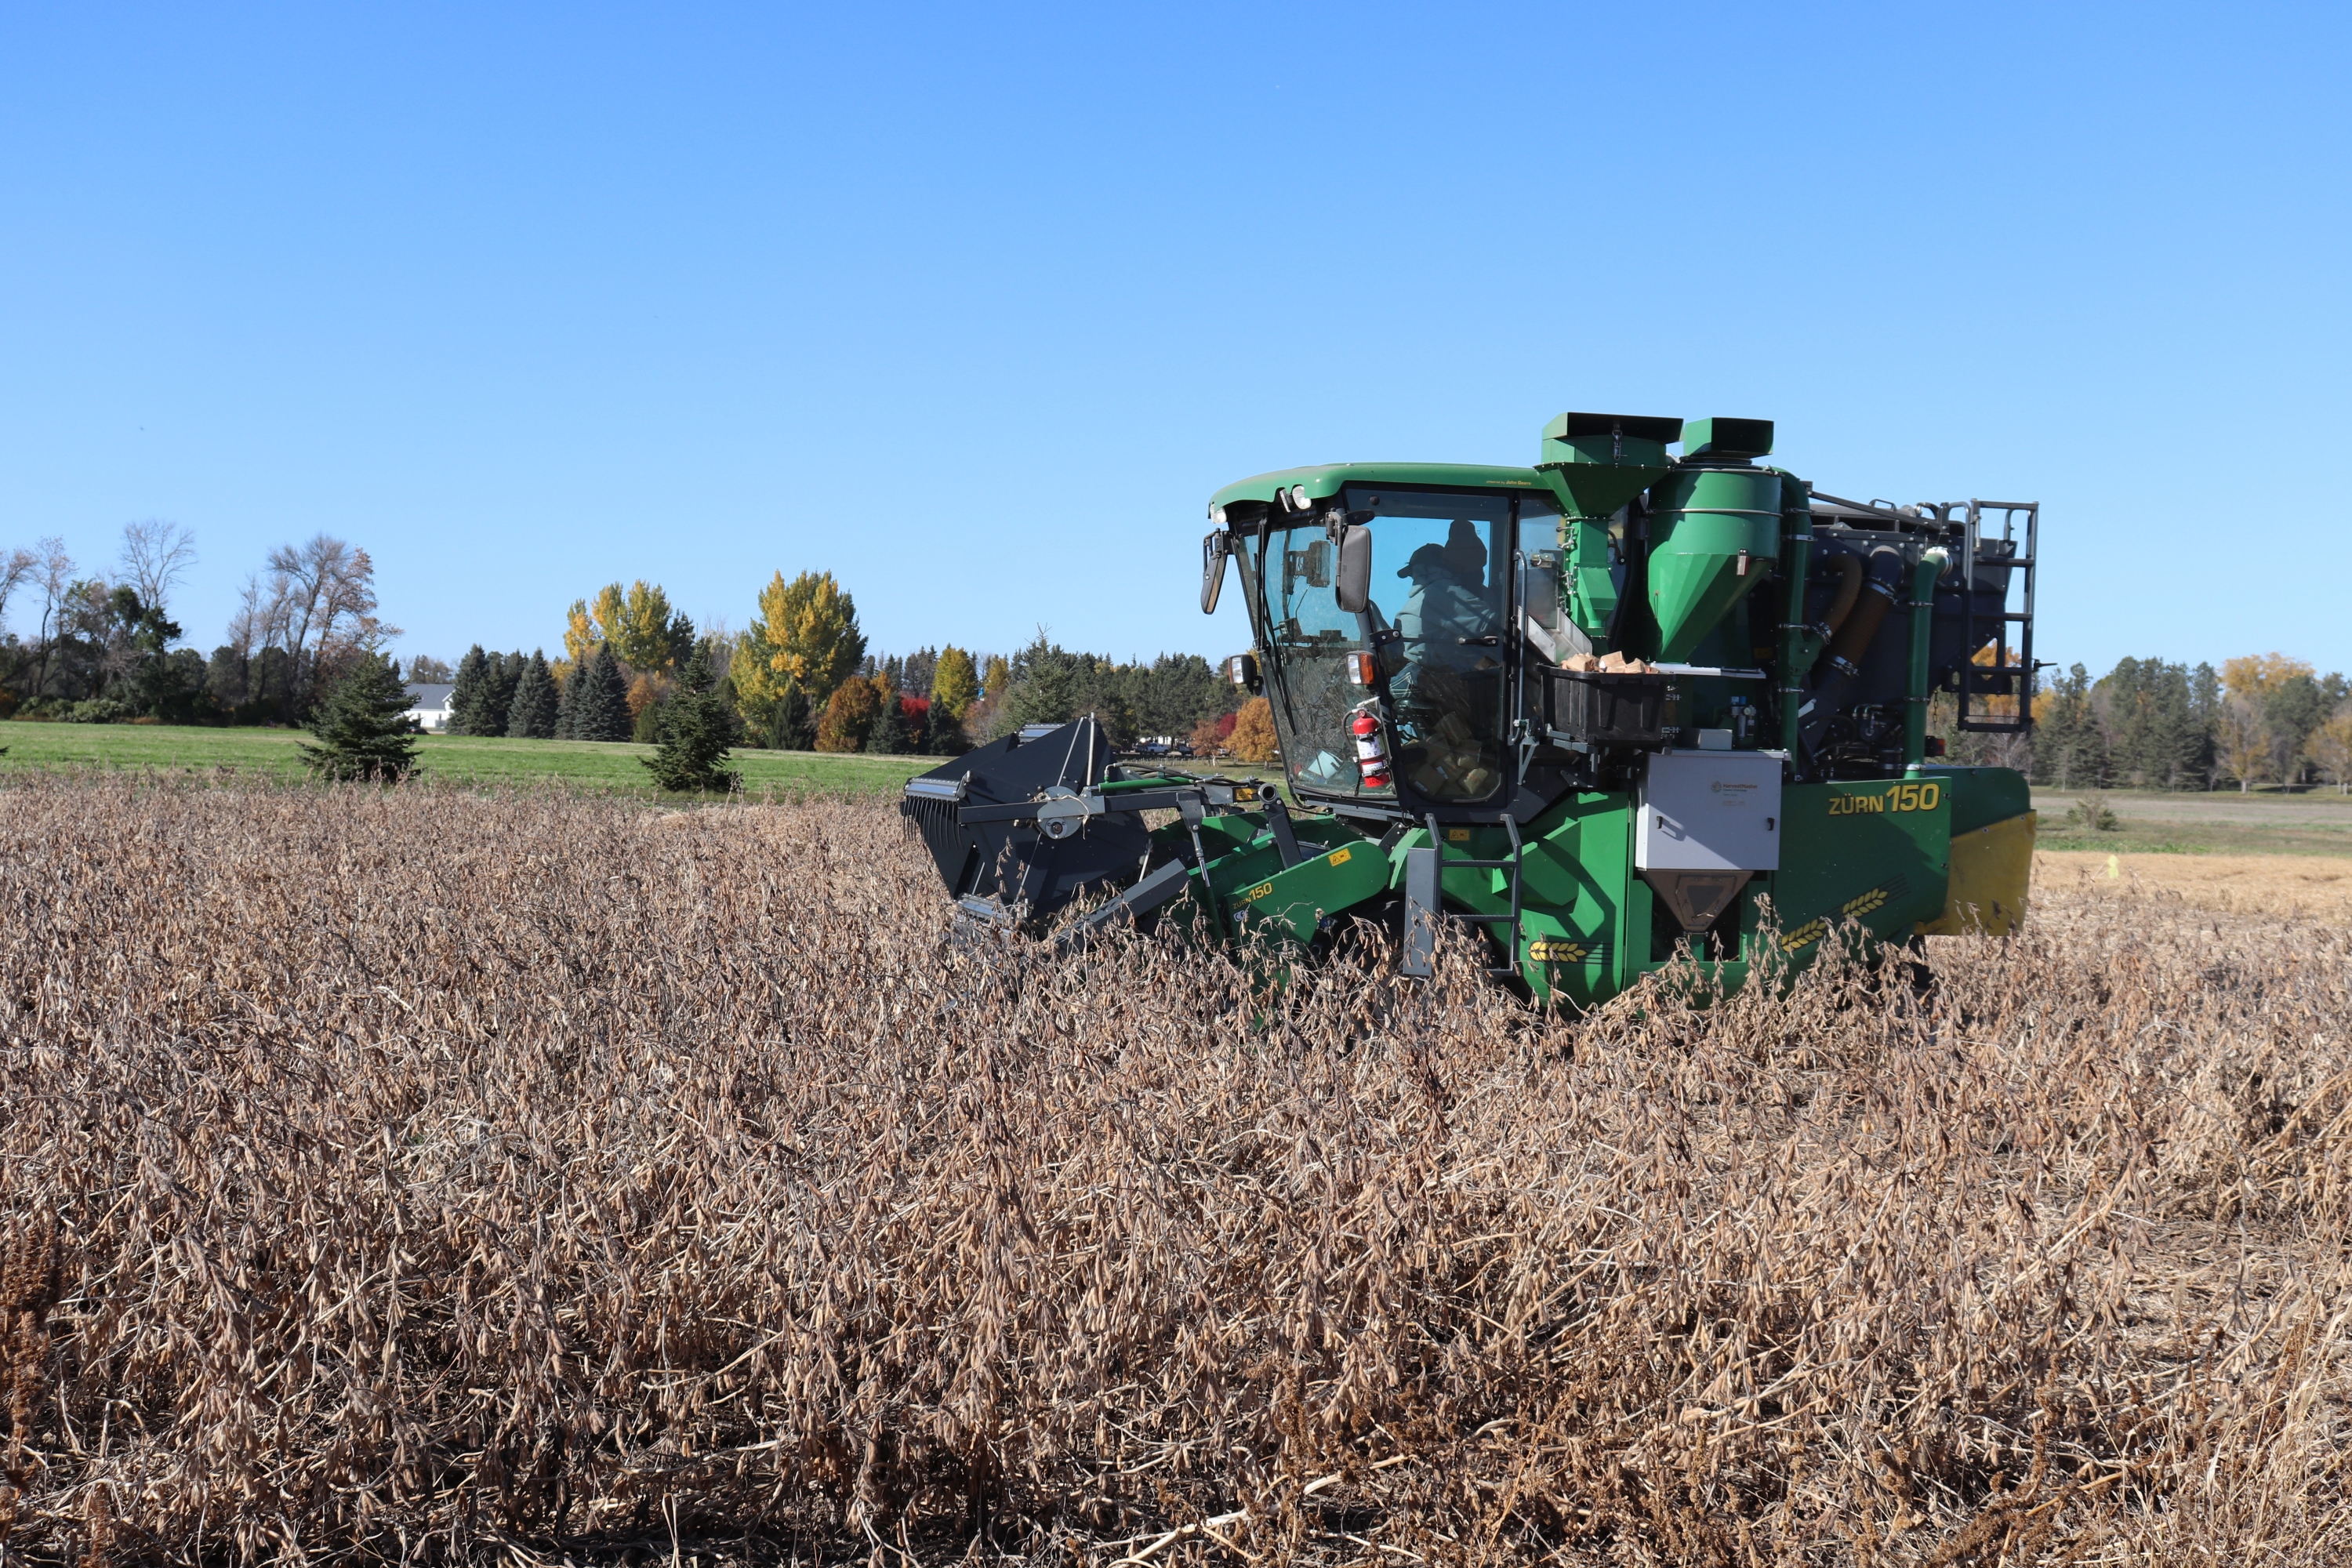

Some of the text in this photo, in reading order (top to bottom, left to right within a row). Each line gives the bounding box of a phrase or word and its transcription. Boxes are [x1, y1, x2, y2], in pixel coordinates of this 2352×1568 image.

[1828, 783, 1940, 815] ZÜRN 150
[1249, 882, 1272, 900] 150
